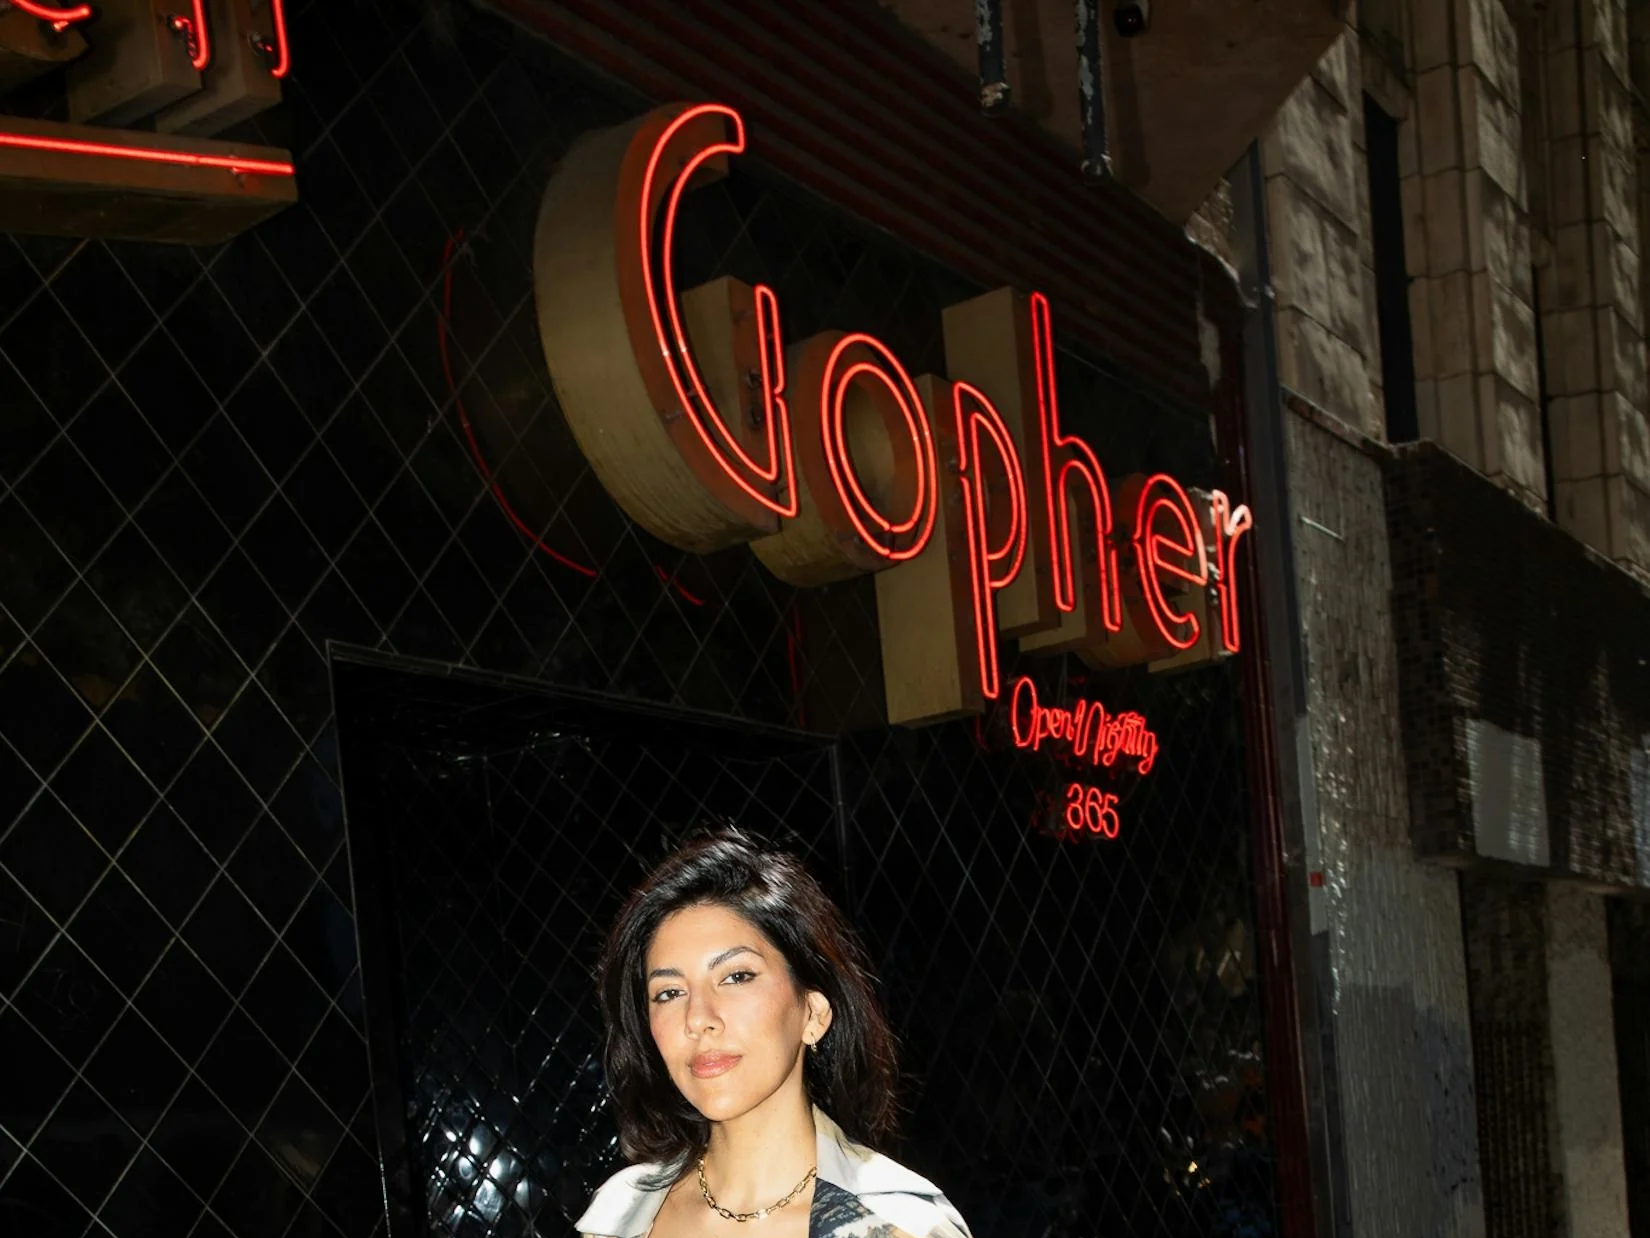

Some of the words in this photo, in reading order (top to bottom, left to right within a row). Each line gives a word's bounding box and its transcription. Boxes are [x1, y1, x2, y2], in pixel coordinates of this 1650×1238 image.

[622, 102, 1252, 704] Gopher
[1012, 676, 1075, 751] Open
[1066, 782, 1119, 839] 365
